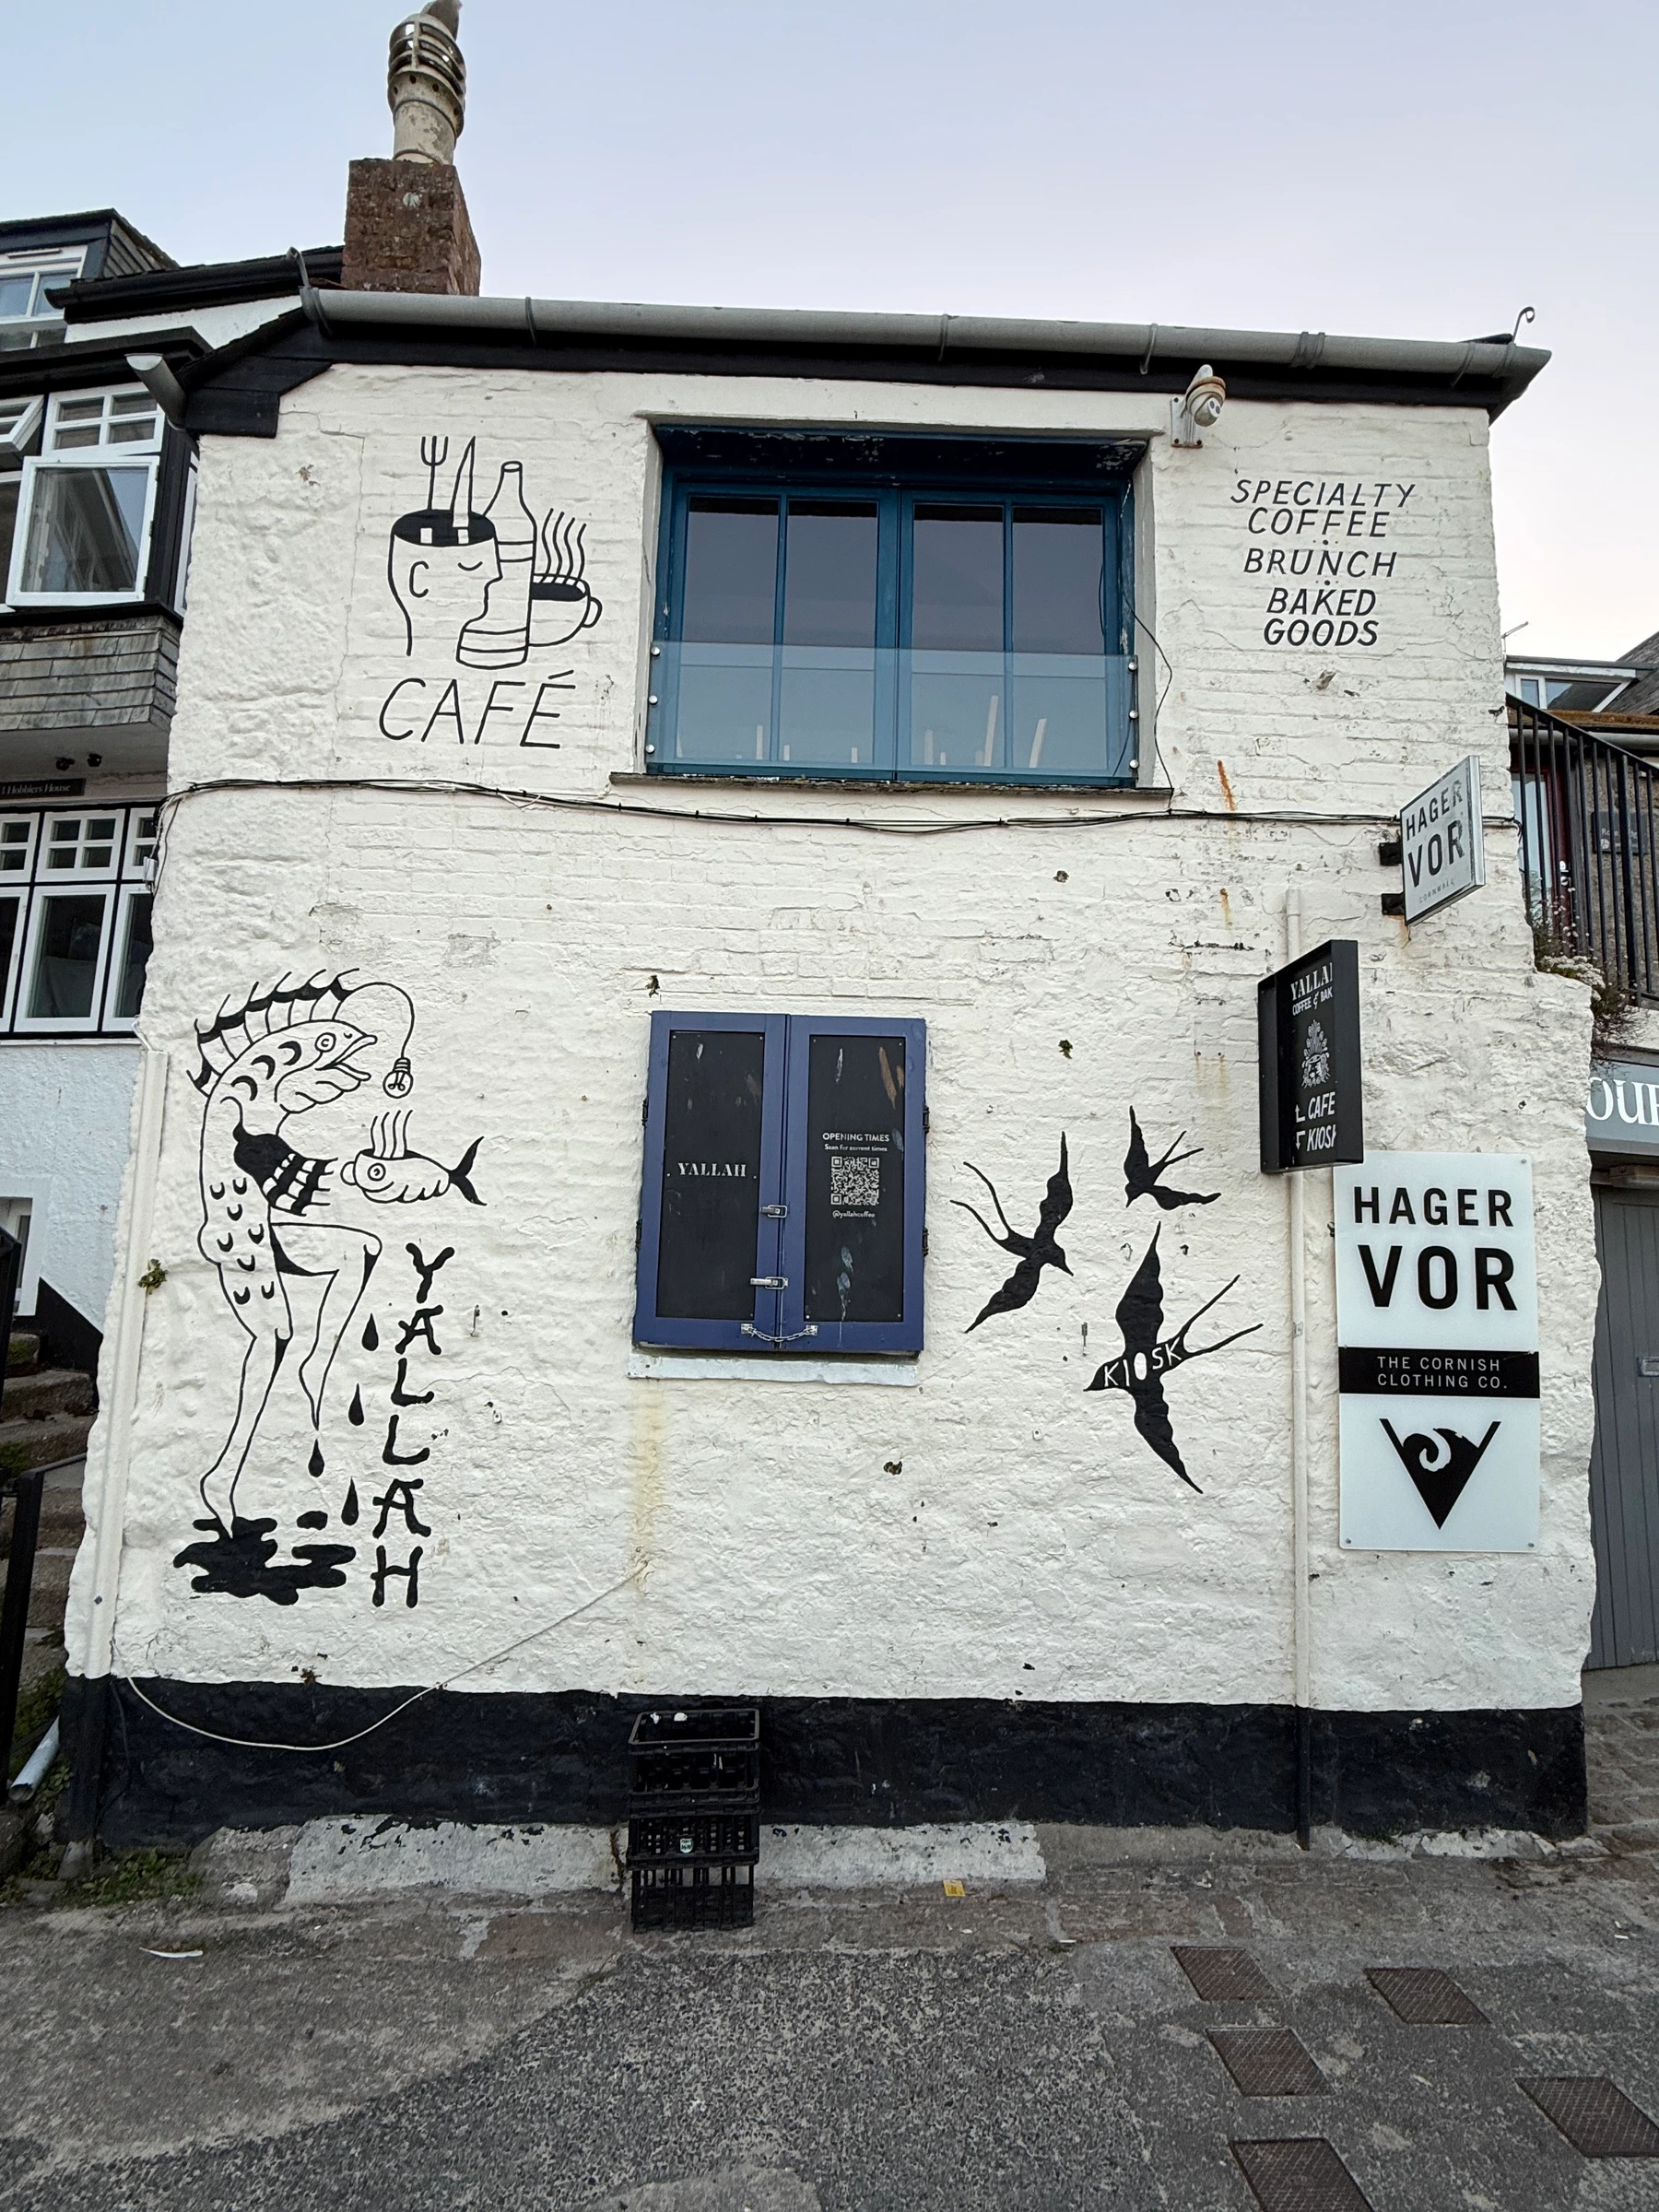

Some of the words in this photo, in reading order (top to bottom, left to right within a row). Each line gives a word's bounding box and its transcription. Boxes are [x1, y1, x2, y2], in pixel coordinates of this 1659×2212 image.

[1230, 479, 1416, 508] SPECIALTY
[1248, 507, 1390, 537] COFFEE
[1243, 547, 1397, 578] BRUNCH
[1265, 587, 1376, 617] BAKED
[1264, 618, 1379, 647] GOODS
[379, 669, 576, 749] CAFÉ
[44, 783, 71, 793] House
[1406, 780, 1464, 841] HAGER
[1407, 819, 1465, 888] VOR
[1419, 878, 1454, 903] CORNWALL
[1292, 996, 1312, 1016] COFFEE
[1308, 1091, 1335, 1120] CAFE
[1585, 1077, 1659, 1126] OU
[822, 1132, 864, 1142] OPENING
[864, 1133, 890, 1142] TIMES
[677, 1162, 747, 1177] YALLAH
[832, 1209, 876, 1218] @yallahcoffee
[1353, 1186, 1514, 1228] HAGER
[1358, 1244, 1518, 1311] VOR
[1104, 1336, 1182, 1387] KIOSK
[1377, 1356, 1411, 1370] THE
[1419, 1357, 1500, 1371] CORNISH
[1377, 1373, 1468, 1388] CLOTHING
[1477, 1376, 1508, 1389] CO.
[370, 1242, 455, 1608] YALLAH
